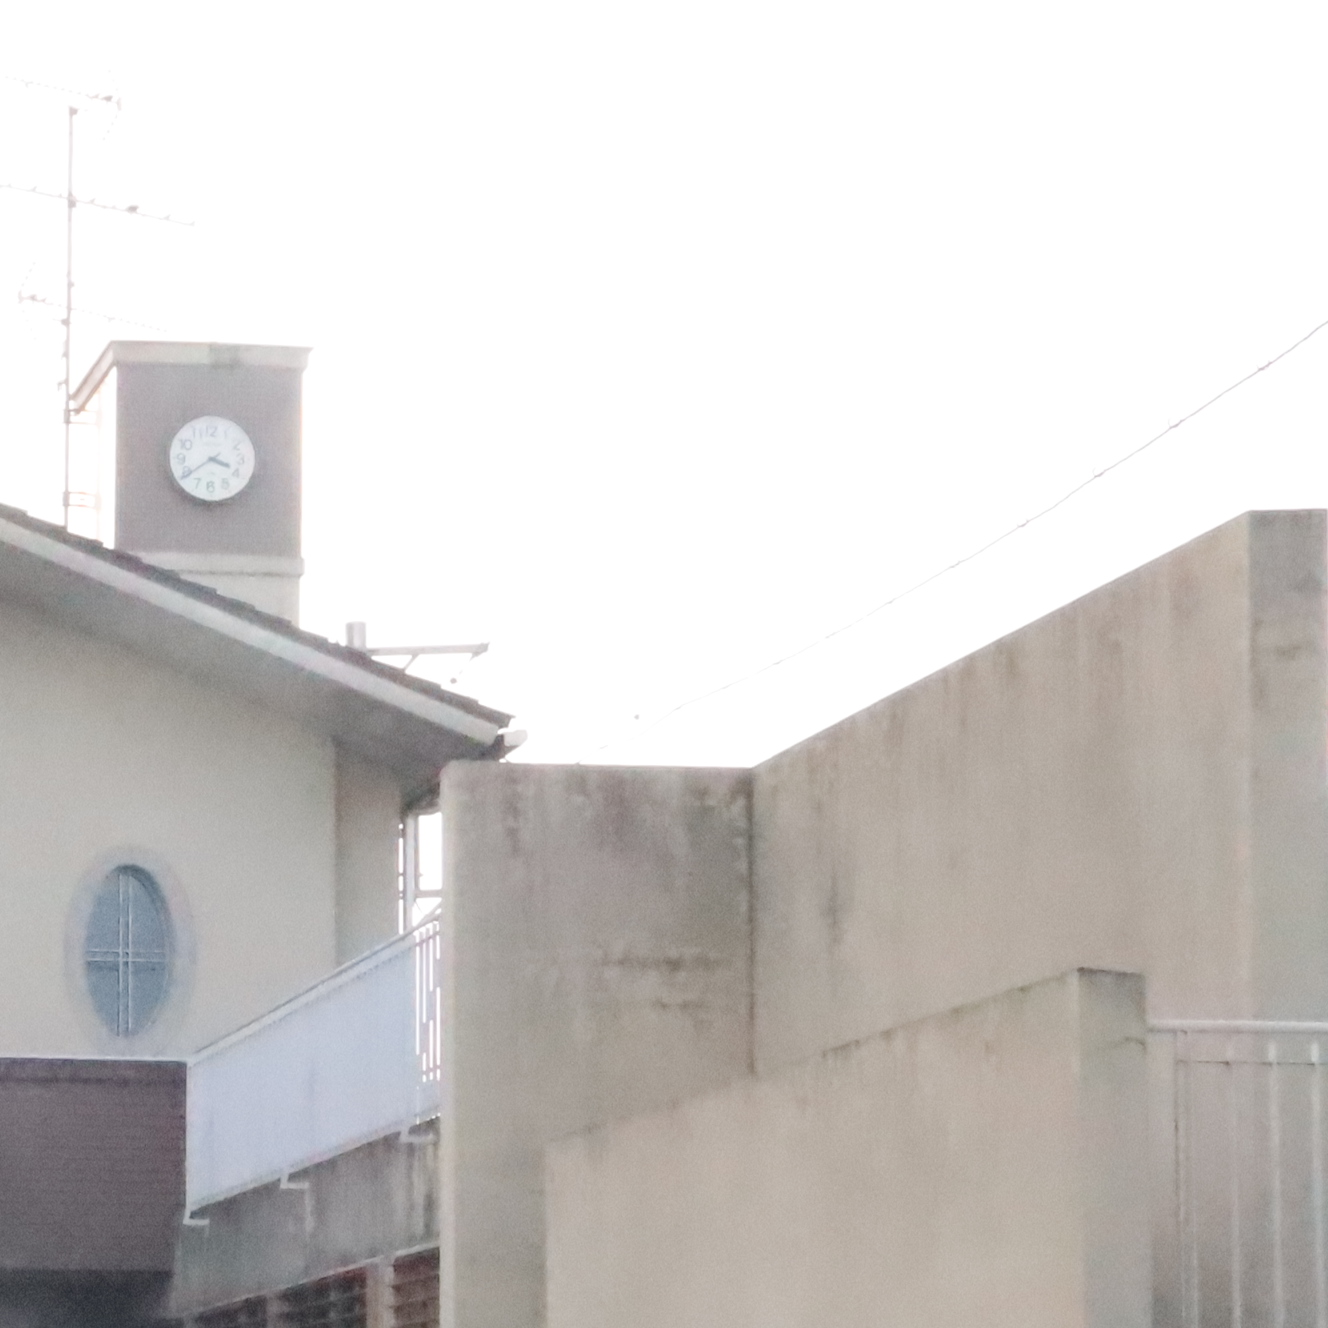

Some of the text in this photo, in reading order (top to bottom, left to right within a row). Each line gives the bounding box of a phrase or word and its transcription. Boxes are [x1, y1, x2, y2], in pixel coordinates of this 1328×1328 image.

[205, 425, 217, 437] 12
[178, 439, 192, 450] 10
[176, 453, 186, 465] 9
[231, 468, 240, 478] 4
[194, 477, 201, 489] 7
[206, 480, 215, 493] 6
